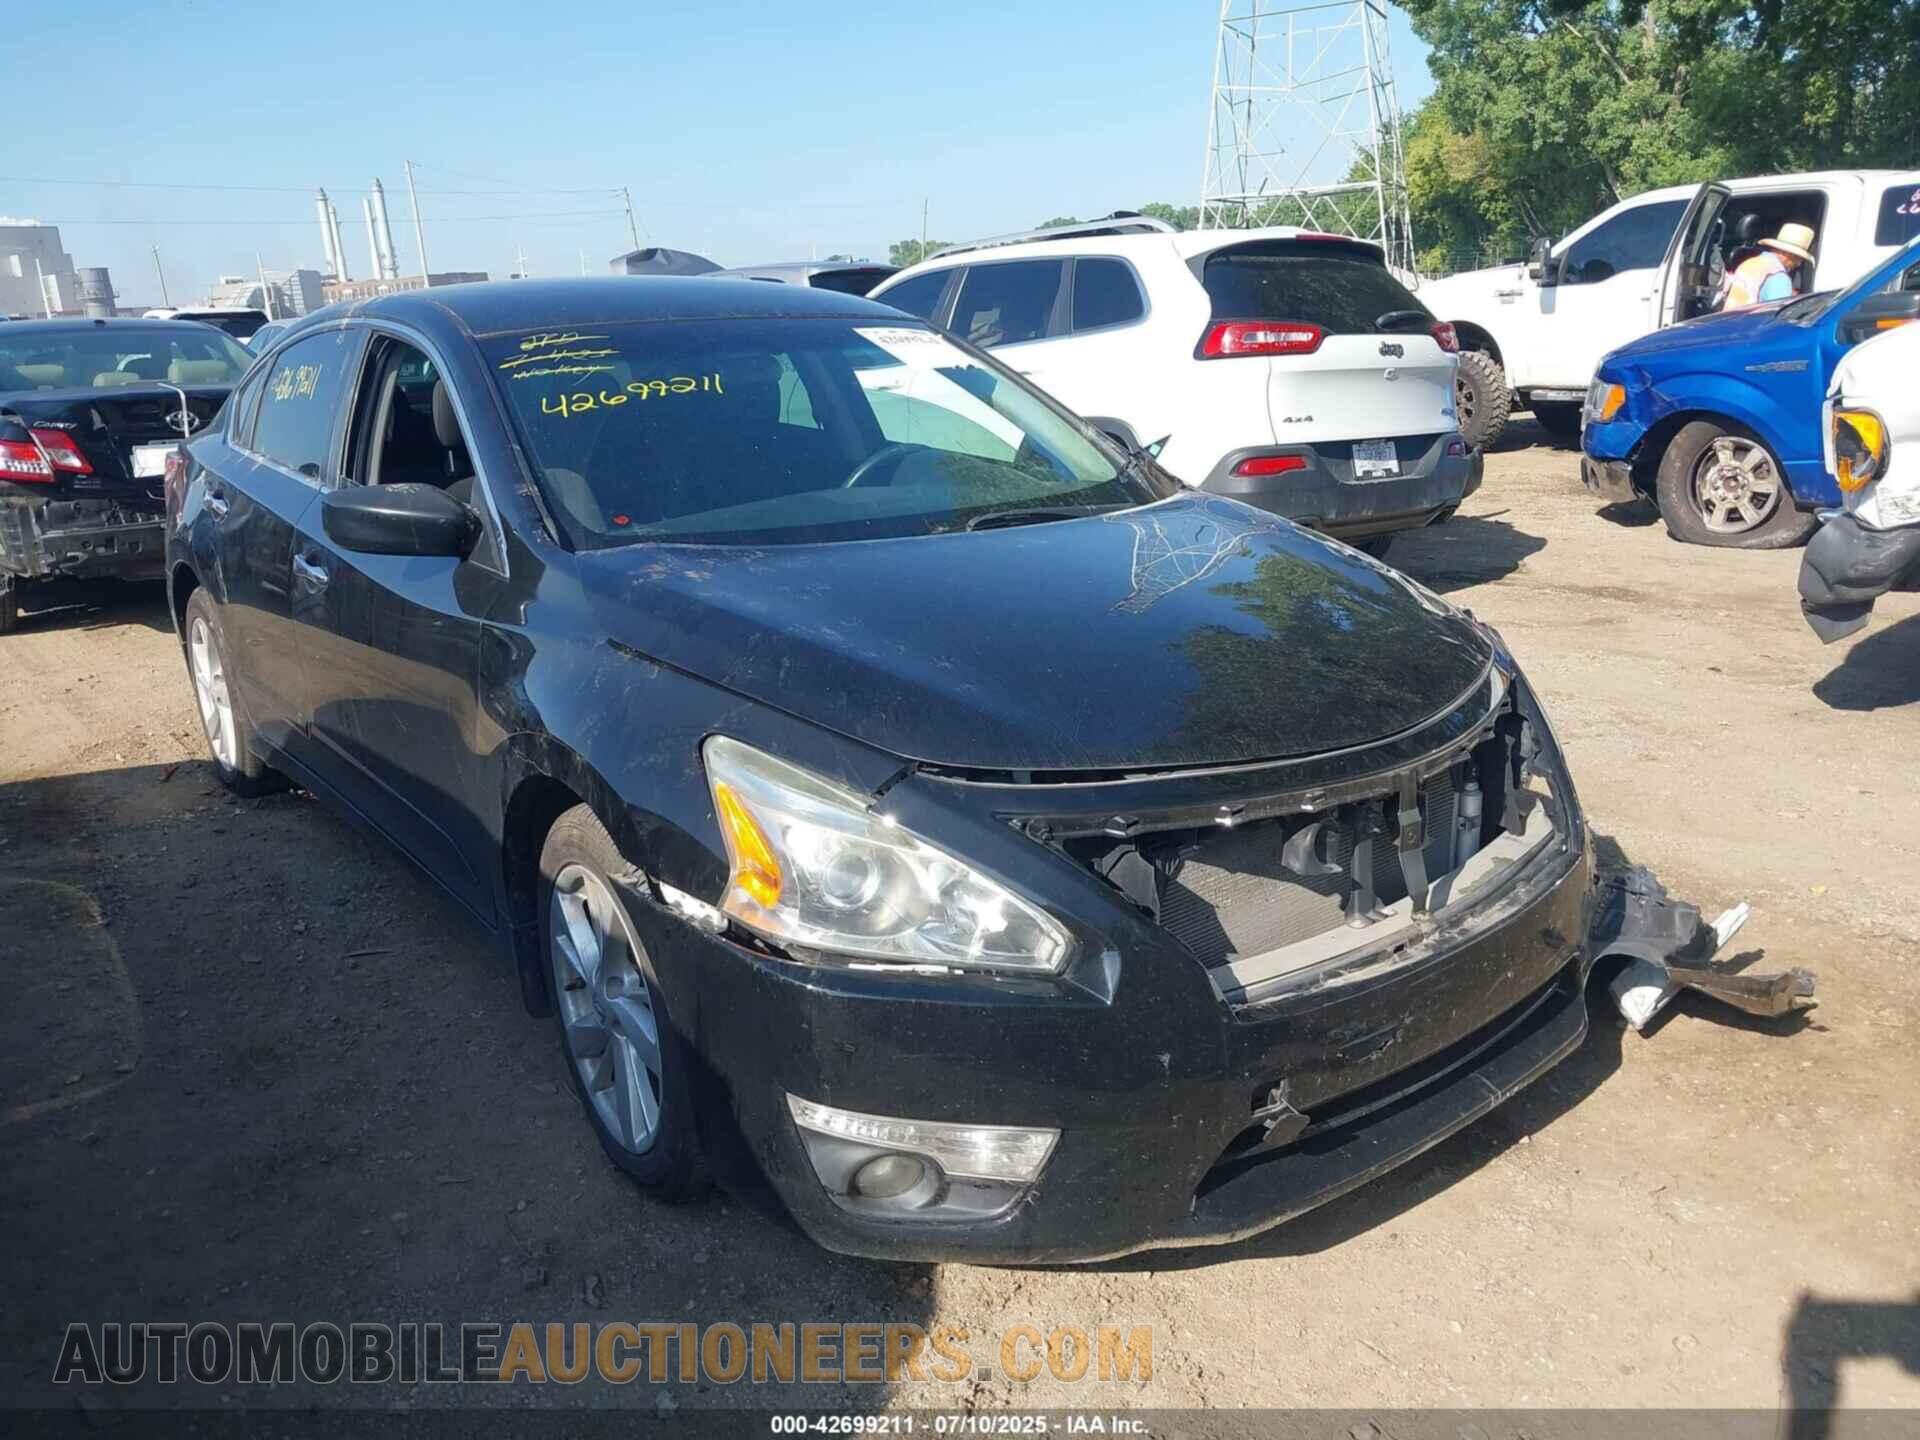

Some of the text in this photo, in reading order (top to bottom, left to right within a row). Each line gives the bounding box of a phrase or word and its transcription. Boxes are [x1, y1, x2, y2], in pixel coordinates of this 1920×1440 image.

[1378, 341, 1405, 359] Jeep
[541, 374, 724, 418] 42699211
[1282, 415, 1315, 424] 4x4
